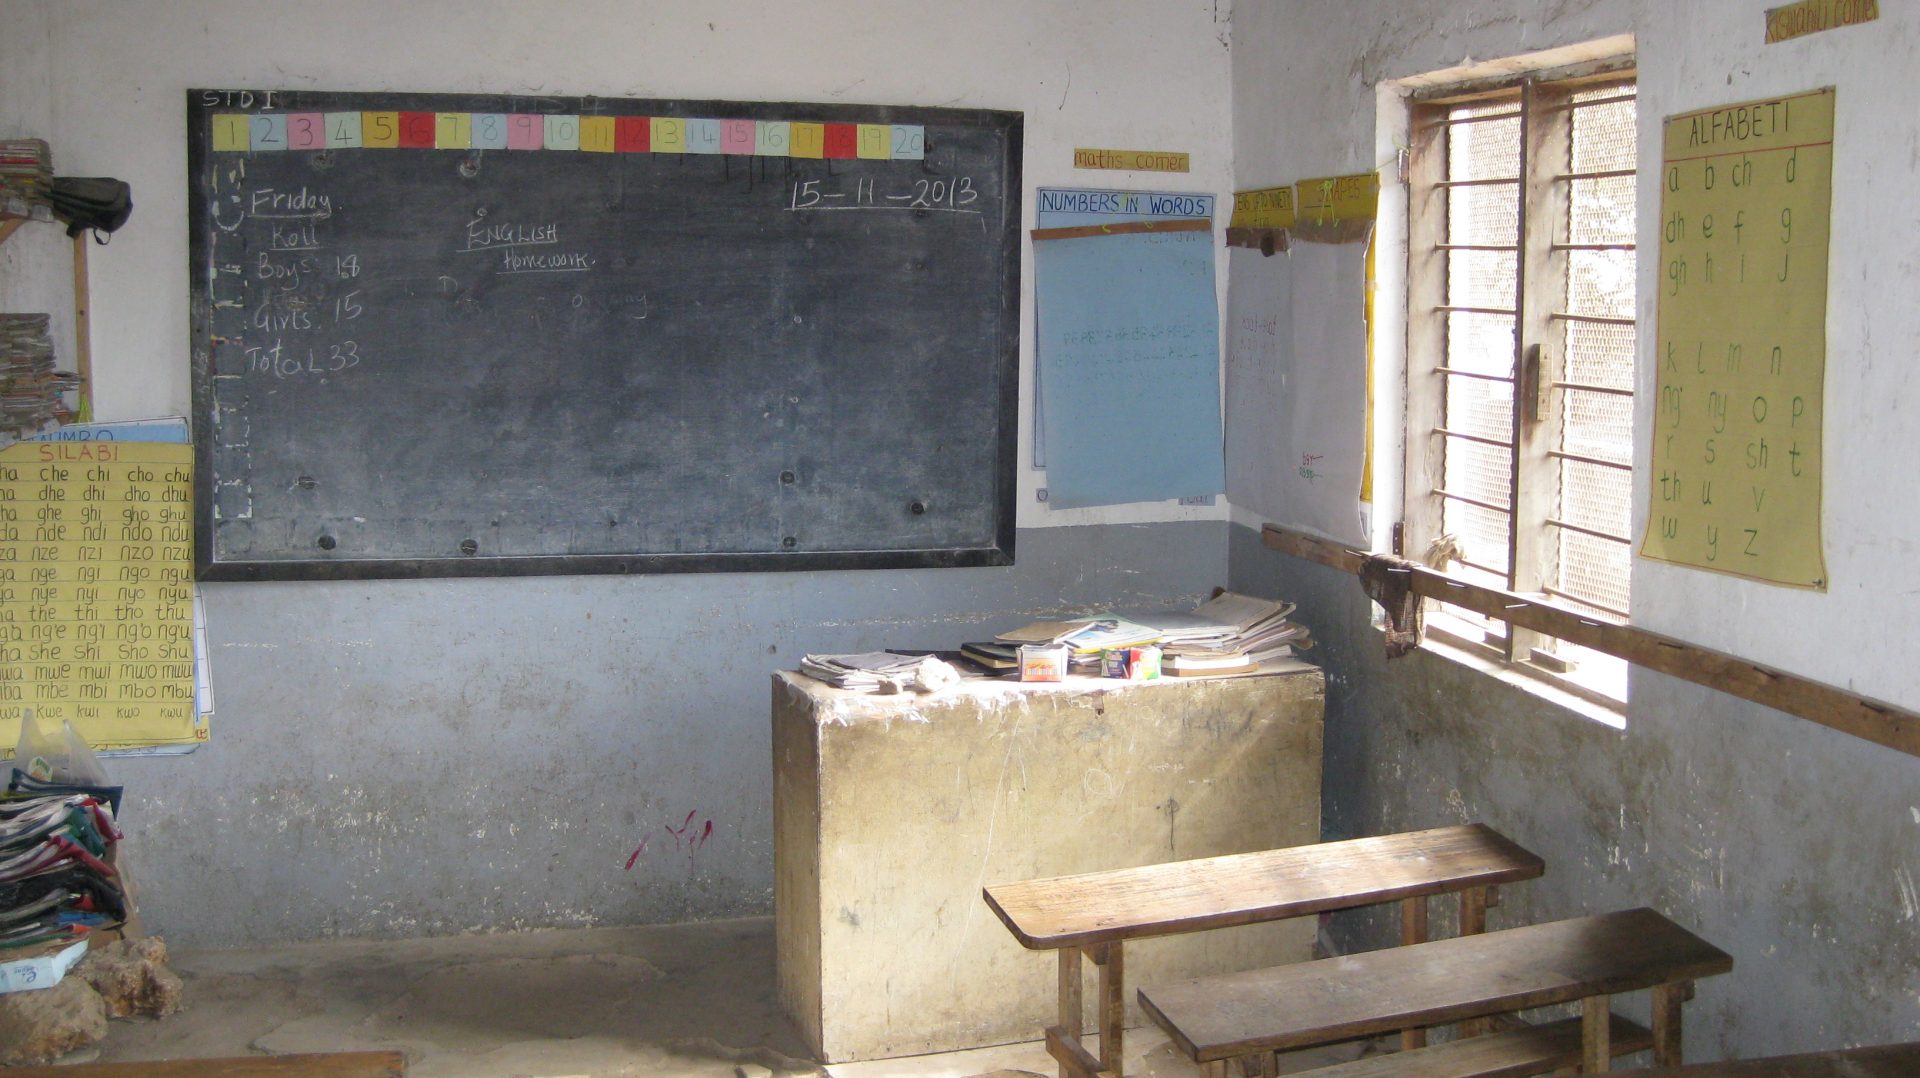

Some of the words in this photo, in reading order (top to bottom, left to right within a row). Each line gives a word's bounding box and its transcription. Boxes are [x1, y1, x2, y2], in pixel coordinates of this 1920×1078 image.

[202, 90, 254, 108] STD
[259, 117, 279, 143] 2
[297, 118, 313, 146] 3
[335, 119, 353, 144] 4
[373, 116, 392, 140] 5
[409, 117, 430, 143] 6
[444, 116, 458, 142] 7
[481, 115, 498, 141] 8
[517, 116, 531, 144] 9
[550, 119, 574, 143] 10
[594, 122, 608, 146] 11
[655, 120, 679, 144] 13
[691, 121, 717, 144] 14
[728, 122, 748, 144] 15
[762, 124, 783, 148] 16
[796, 127, 813, 148] 17
[863, 127, 882, 151] 19
[895, 127, 923, 154] 20
[1690, 101, 1789, 148] ALFABETI
[1074, 150, 1123, 169] maths
[1669, 167, 1680, 192] a
[1704, 156, 1715, 190] b
[1732, 152, 1751, 187] ch
[1786, 146, 1797, 183] d
[1042, 192, 1120, 212] NUMBERS
[1125, 195, 1138, 212] IN
[1150, 196, 1205, 215] WORDS
[1666, 211, 1685, 243] dh
[1702, 214, 1713, 238] e
[1734, 210, 1744, 244] f
[1781, 208, 1792, 244] g
[258, 252, 312, 291] Boys
[1669, 255, 1687, 296] gh
[335, 290, 362, 322] 15
[329, 340, 360, 371] 33
[1666, 341, 1677, 373] k
[1771, 346, 1782, 376] n
[1708, 391, 1727, 434] ny
[40, 444, 118, 462] SILABI
[1788, 441, 1801, 477] t
[0, 466, 18, 481] ha
[40, 464, 69, 481] che
[87, 465, 110, 481] chi
[127, 466, 154, 482] cho
[164, 466, 190, 482] chu
[39, 485, 65, 501] dhe
[83, 485, 106, 501] dhi
[125, 485, 150, 501] dho
[162, 485, 188, 502] dhu
[1660, 470, 1681, 502] th
[1702, 481, 1712, 505] u
[0, 503, 17, 521] ha
[38, 503, 62, 526] ghe
[80, 504, 101, 525] ghi
[122, 506, 150, 526] gho
[159, 506, 186, 523] ghu
[0, 522, 19, 541] da
[36, 522, 66, 541] nde
[83, 522, 106, 541] ndi
[121, 522, 152, 542] ndo
[162, 522, 190, 541] ndu
[1707, 525, 1717, 561] y
[32, 546, 58, 560] nze
[78, 546, 102, 560] nzi
[120, 545, 153, 561] nzo
[162, 546, 190, 561] nzu
[32, 567, 57, 585] nge
[78, 566, 100, 584] ngi
[119, 566, 150, 584] ngo
[160, 567, 190, 586] ngu
[32, 587, 57, 606] nye
[77, 587, 98, 606] nyi
[118, 587, 146, 605] nyo
[159, 587, 189, 605] nyu
[28, 605, 56, 621] the
[74, 604, 98, 621] thi
[115, 604, 143, 621] tho
[155, 604, 186, 620] thu
[0, 643, 21, 661] ha
[0, 666, 23, 680] wa
[35, 664, 70, 680] mwe
[79, 665, 111, 680] mwi
[120, 663, 157, 680] mwo
[162, 664, 193, 679] mwu
[0, 682, 23, 700] ba
[36, 683, 69, 699] mbe
[80, 683, 107, 699] mbi
[119, 683, 156, 699] mbo
[161, 683, 194, 699] mbu
[0, 706, 20, 719] wa
